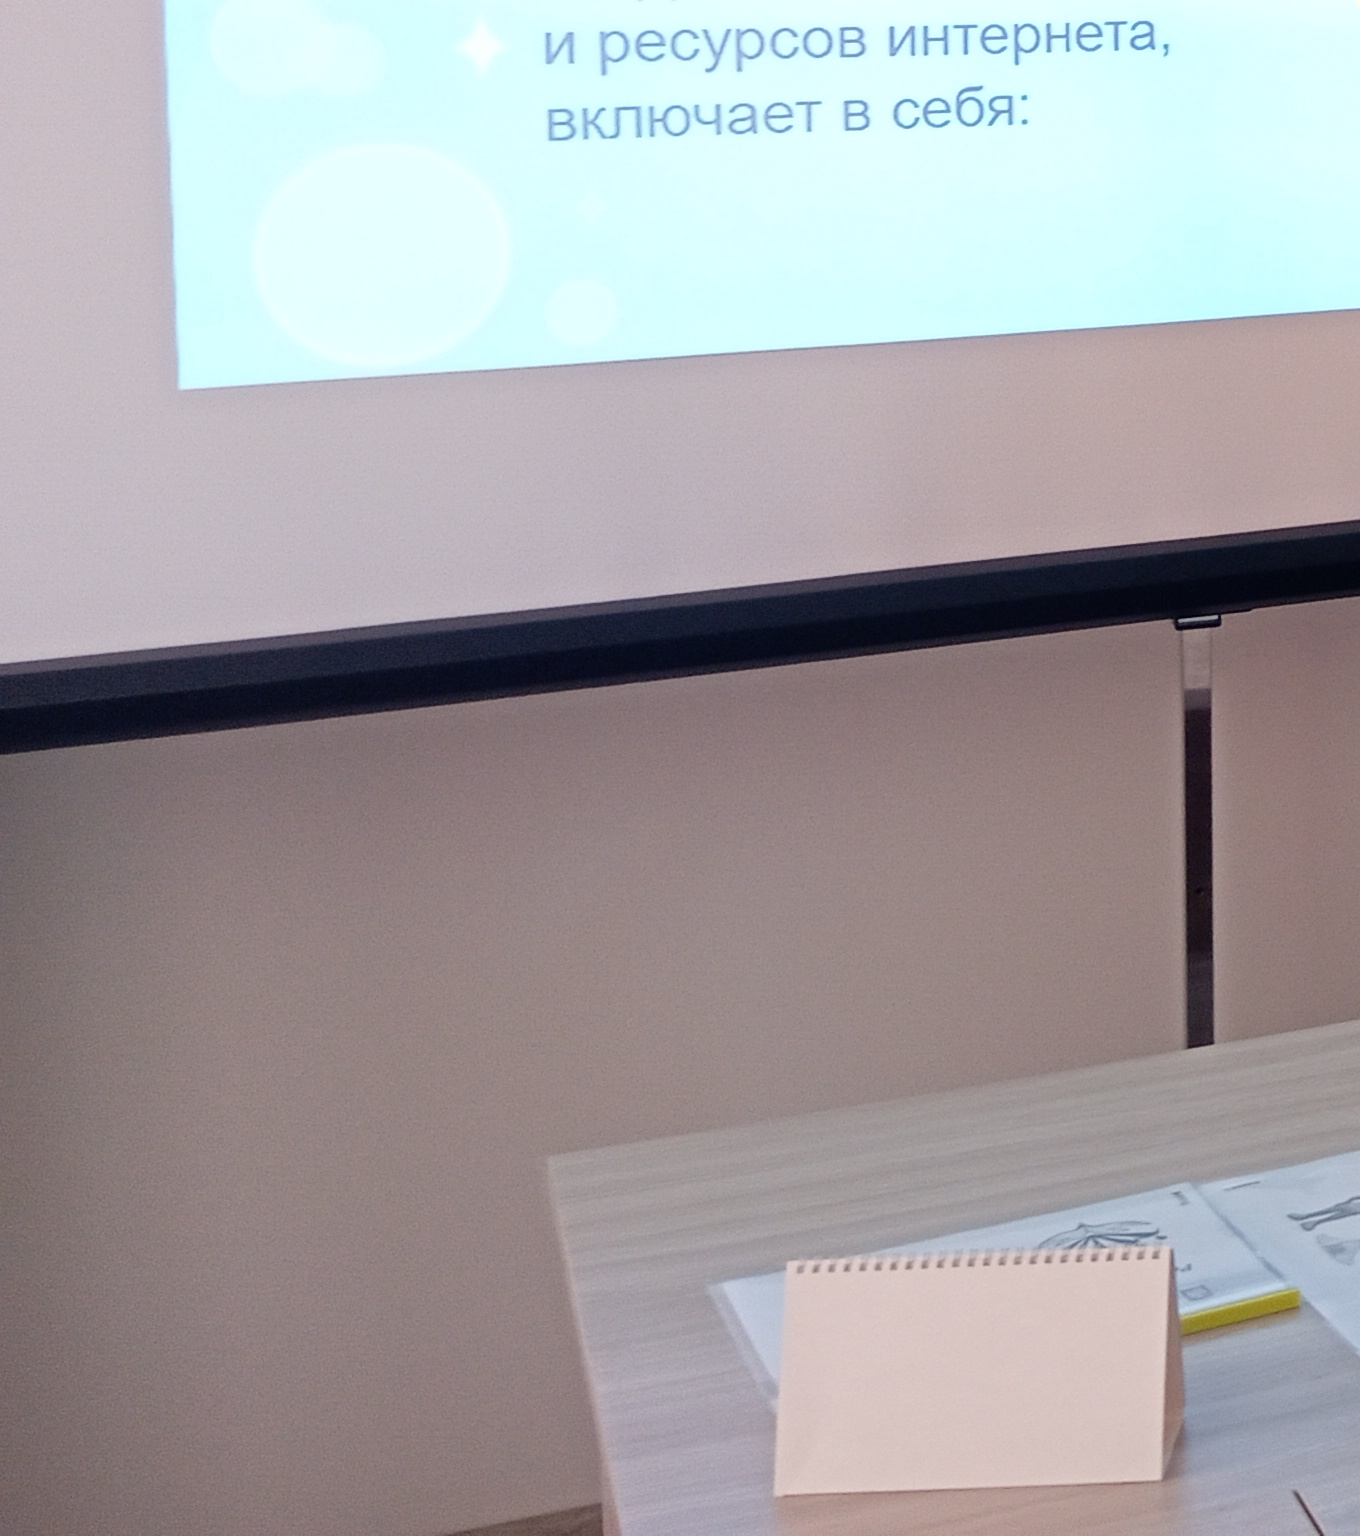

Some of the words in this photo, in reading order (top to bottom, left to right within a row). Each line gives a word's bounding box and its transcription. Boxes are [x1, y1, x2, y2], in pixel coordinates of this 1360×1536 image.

[543, 30, 576, 66] и
[598, 25, 868, 78] ресурсов
[887, 19, 1171, 67] интернета,
[546, 99, 824, 143] включает
[842, 98, 872, 133] в
[891, 84, 1030, 131] себя:
